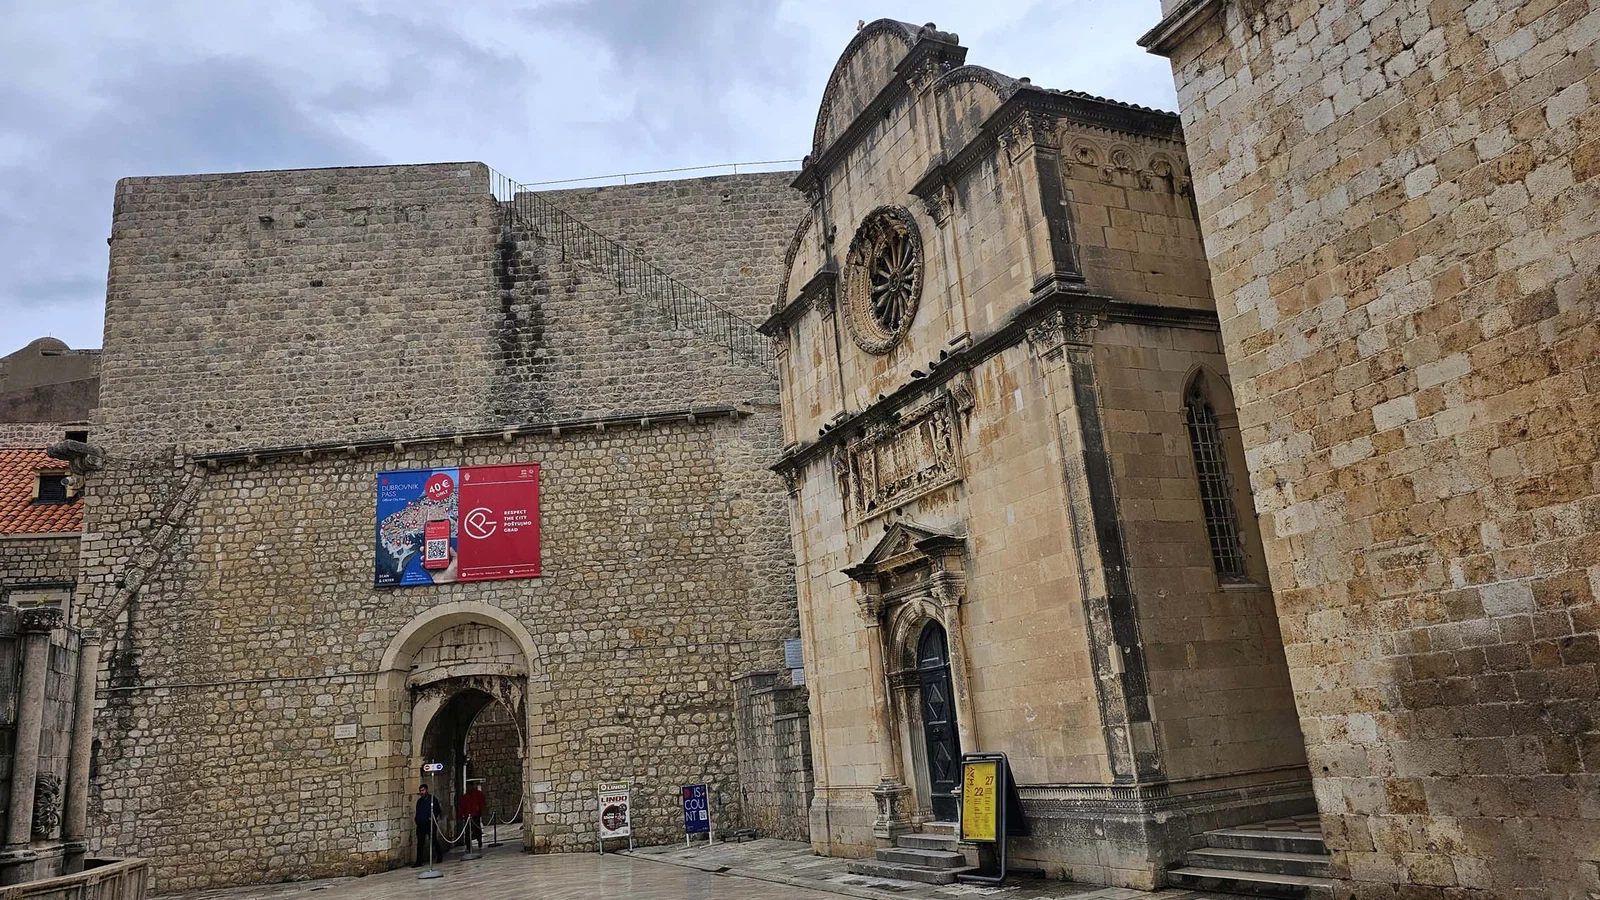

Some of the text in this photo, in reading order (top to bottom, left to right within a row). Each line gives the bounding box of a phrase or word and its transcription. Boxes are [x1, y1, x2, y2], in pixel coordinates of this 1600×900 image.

[429, 479, 450, 494] 40 €
[985, 776, 994, 785] 27
[974, 787, 984, 797] 22
[685, 799, 704, 810] COU
[686, 811, 696, 822] NT
